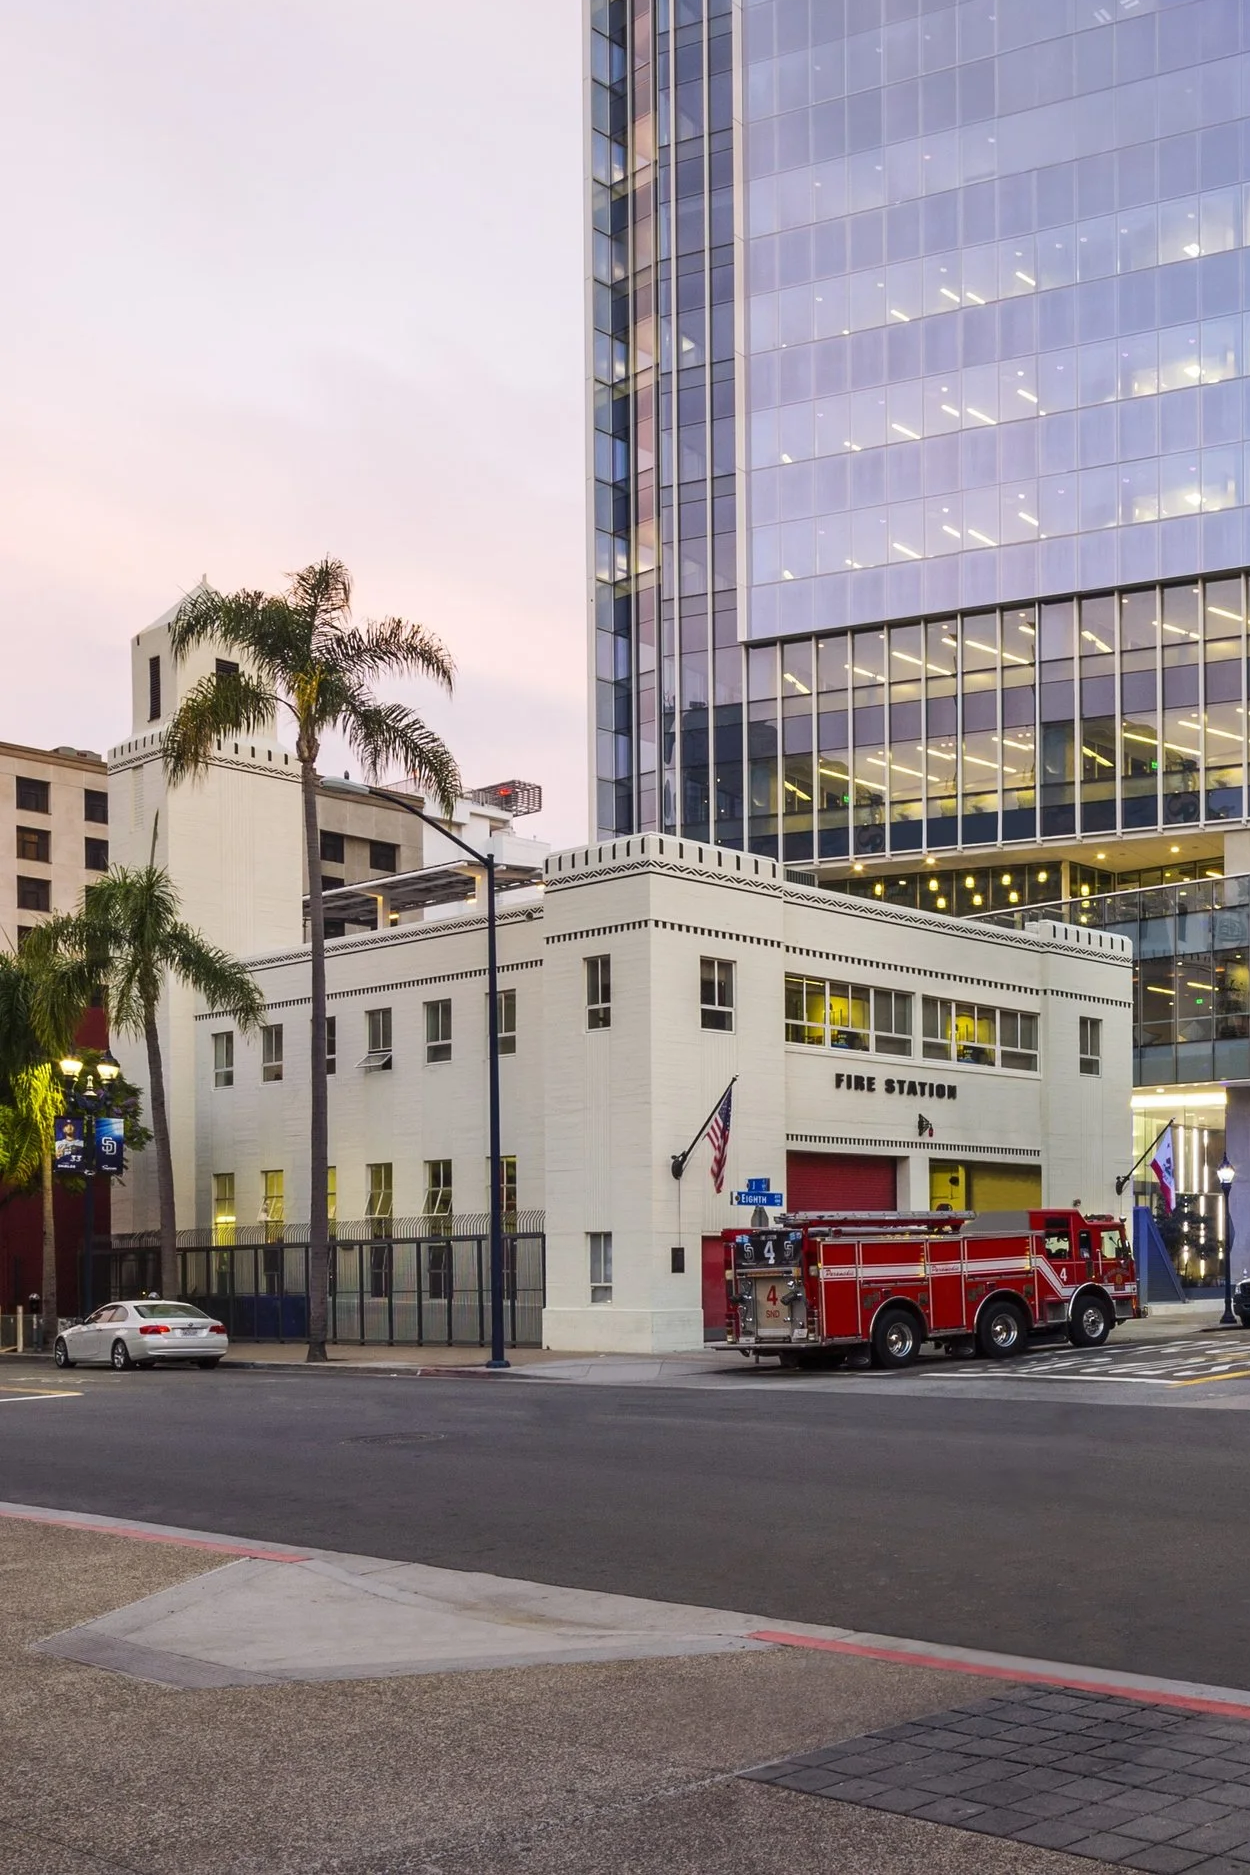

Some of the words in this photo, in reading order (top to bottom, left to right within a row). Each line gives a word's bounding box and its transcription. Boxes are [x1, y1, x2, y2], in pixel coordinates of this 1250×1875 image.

[835, 1073, 876, 1092] FIRE
[884, 1078, 957, 1100] STATION
[741, 1194, 767, 1204] EIGHTH
[763, 1240, 776, 1265] 4
[1059, 1267, 1068, 1282] 4
[766, 1285, 779, 1306] 4
[766, 1309, 780, 1319] SND
